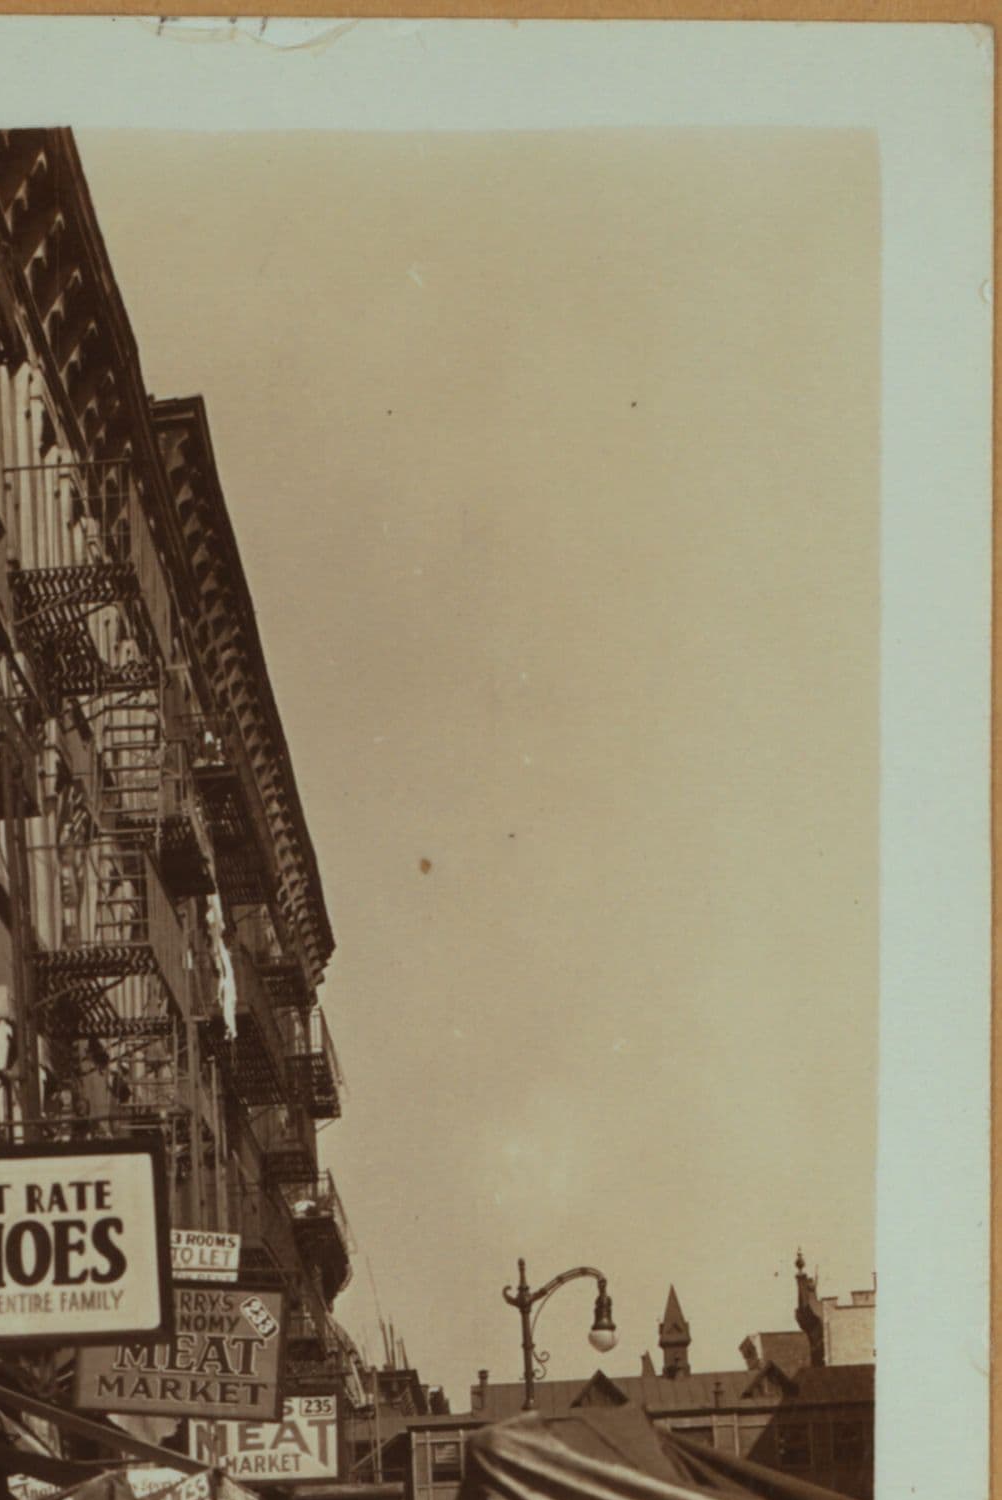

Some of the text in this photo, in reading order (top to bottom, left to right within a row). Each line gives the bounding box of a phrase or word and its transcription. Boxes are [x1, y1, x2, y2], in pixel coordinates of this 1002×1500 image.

[26, 1180, 113, 1214] RATE
[186, 1234, 237, 1248] ROOMS
[198, 1248, 233, 1266] LET
[60, 1290, 124, 1312] FAMILY
[180, 1292, 234, 1313] RRYS
[180, 1315, 240, 1332] NOMY
[112, 1333, 265, 1378] MEAT
[97, 1376, 269, 1406] MARKET
[304, 1400, 332, 1413] 235
[226, 1453, 302, 1473] MARKET
